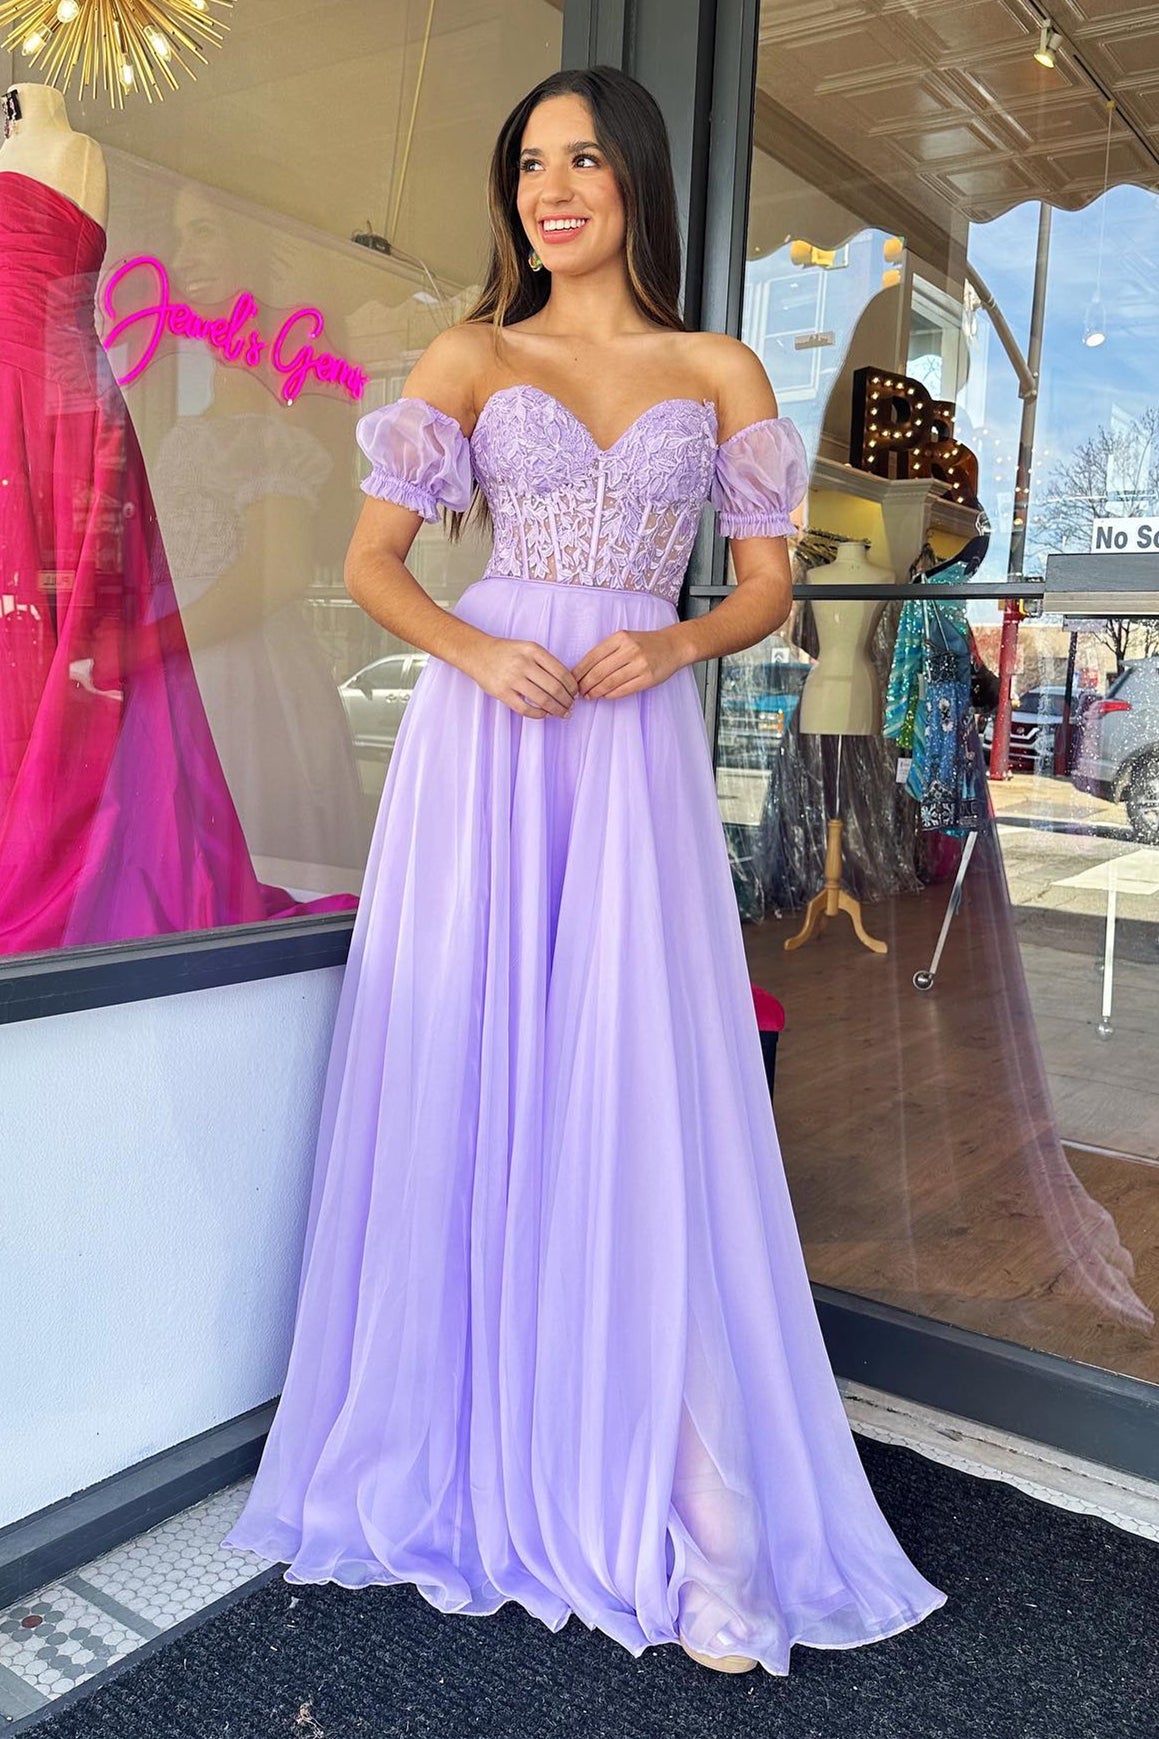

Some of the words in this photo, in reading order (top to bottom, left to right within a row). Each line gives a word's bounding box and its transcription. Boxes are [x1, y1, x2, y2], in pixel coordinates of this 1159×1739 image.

[103, 255, 266, 386] Jewel's
[272, 307, 369, 404] Gems
[1096, 526, 1128, 549] No
